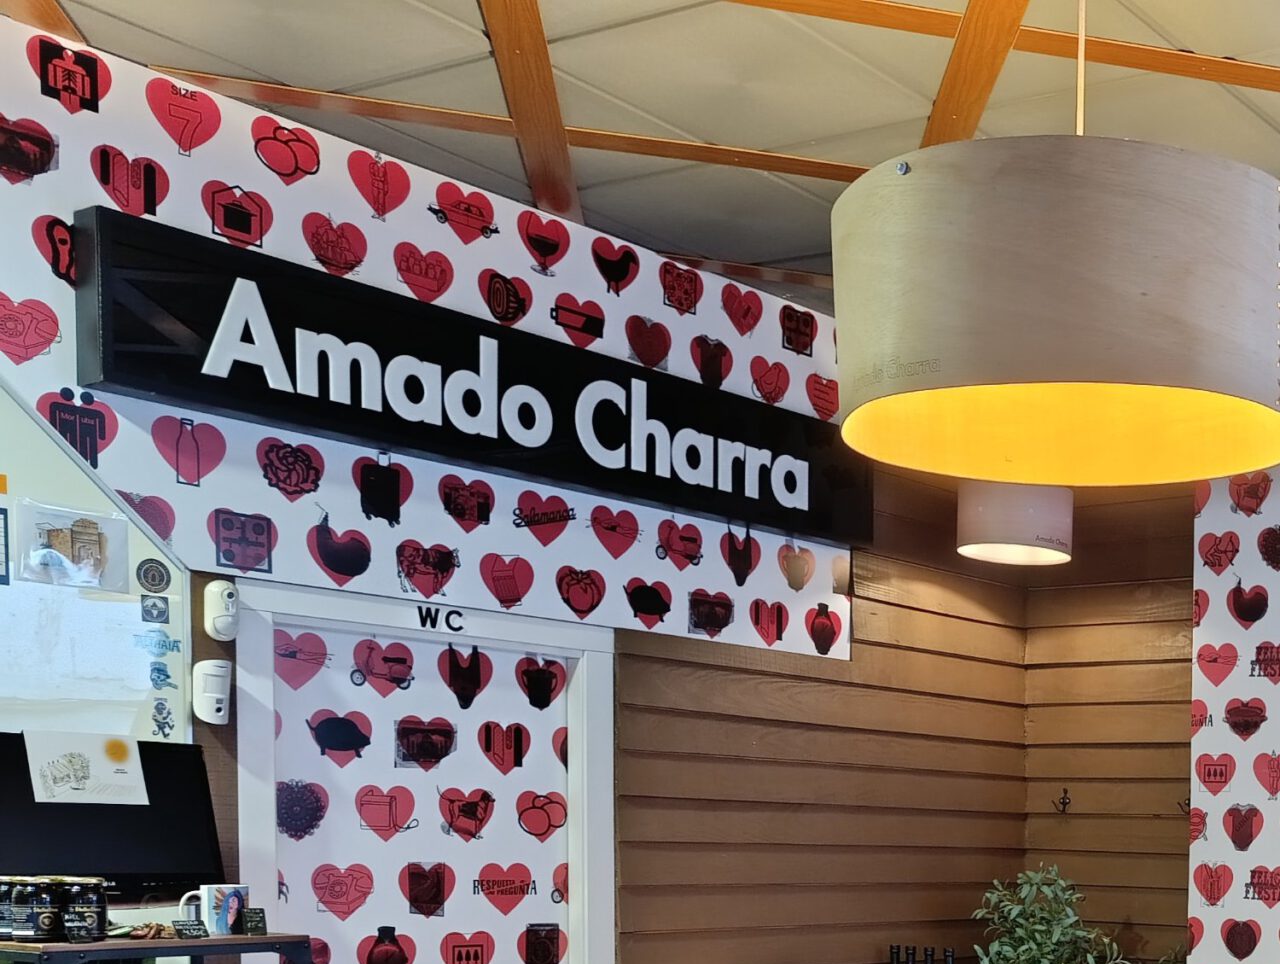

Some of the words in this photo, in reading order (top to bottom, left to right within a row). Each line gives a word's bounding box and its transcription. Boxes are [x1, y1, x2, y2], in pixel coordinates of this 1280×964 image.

[170, 84, 198, 102] SIZE
[168, 104, 202, 157] 7
[201, 277, 553, 448] Amado
[574, 378, 809, 511] Charra
[512, 506, 577, 528] Salamanca
[417, 605, 464, 633] WC
